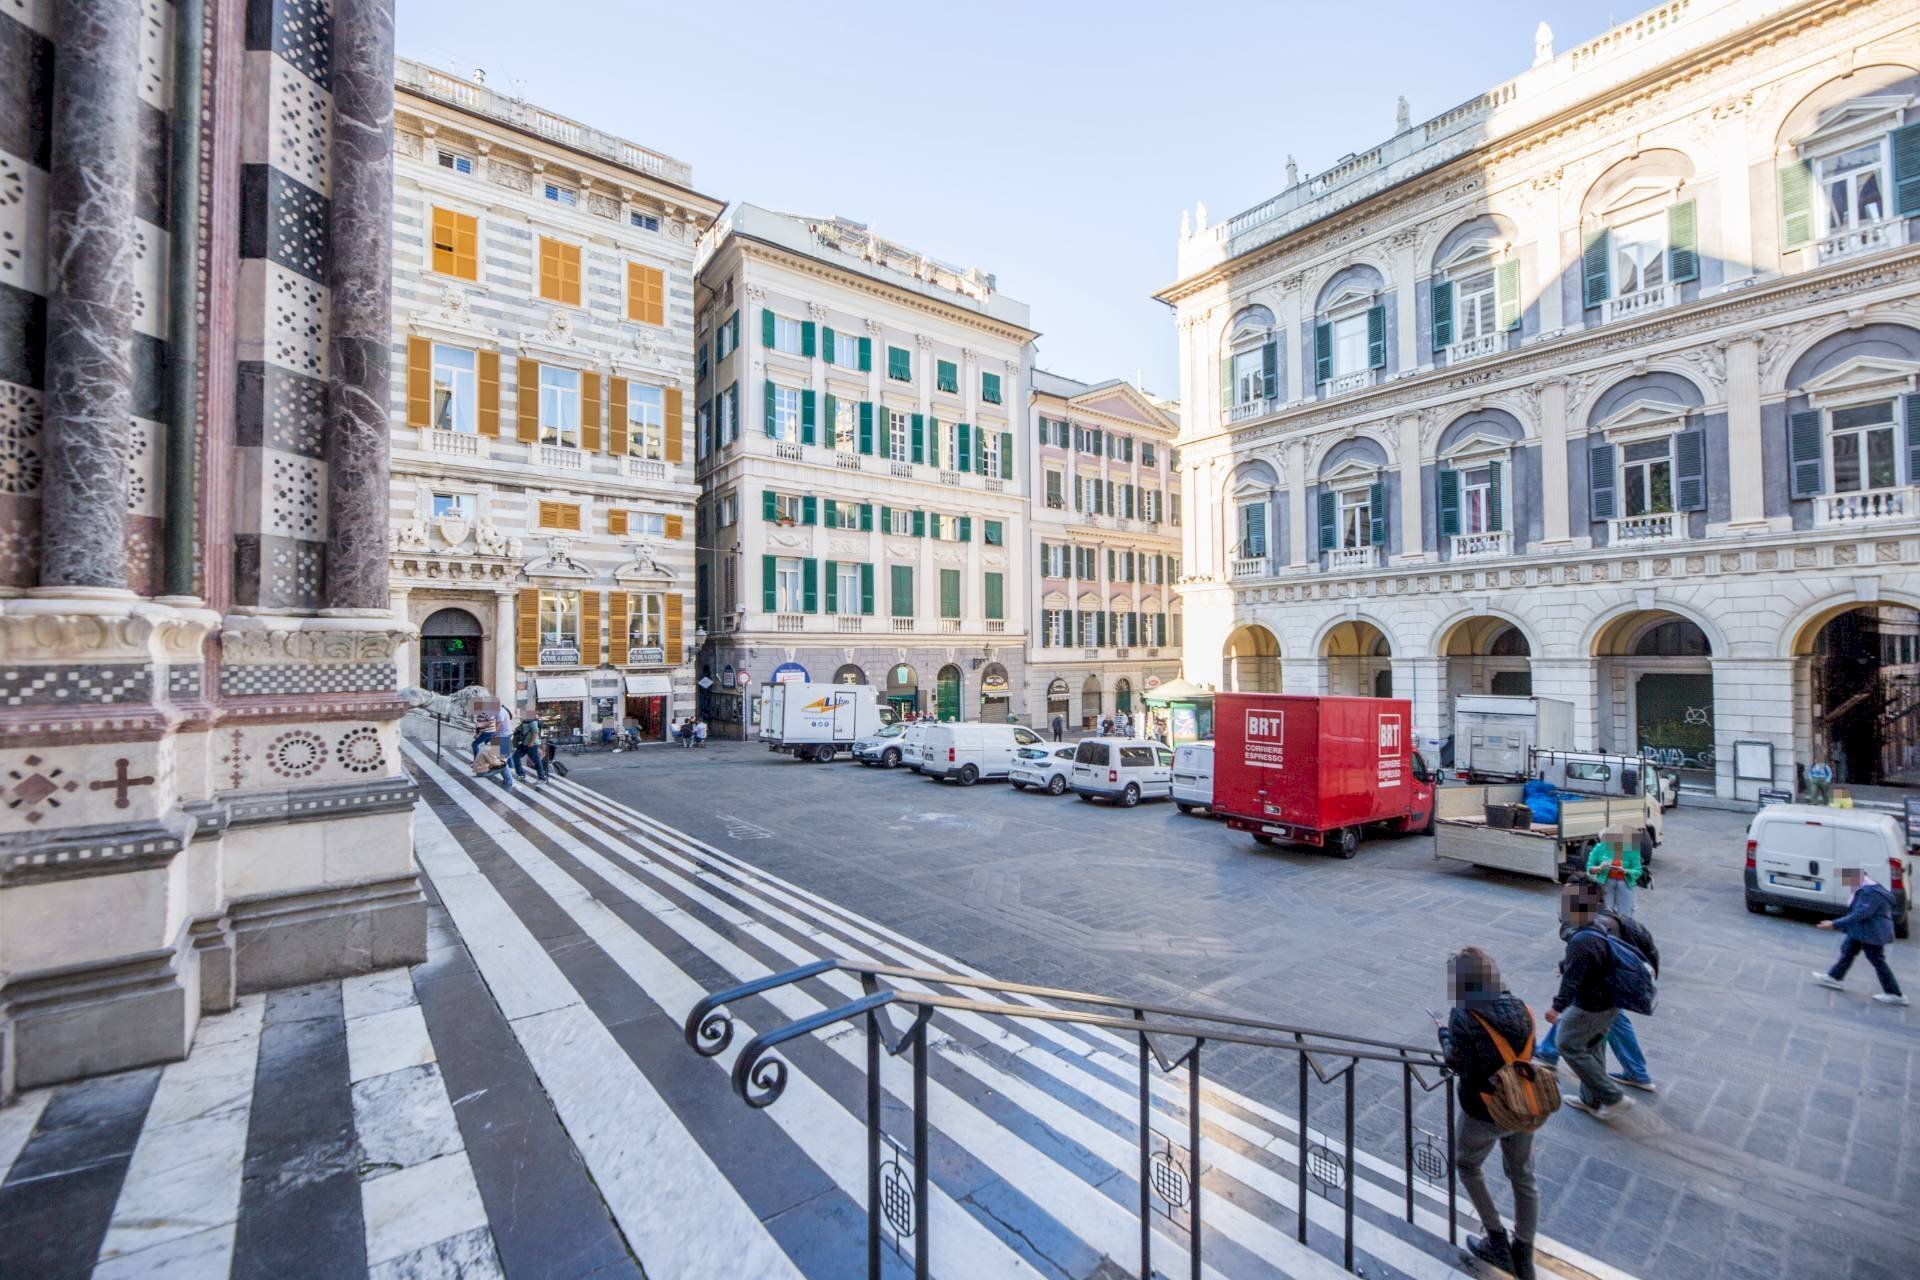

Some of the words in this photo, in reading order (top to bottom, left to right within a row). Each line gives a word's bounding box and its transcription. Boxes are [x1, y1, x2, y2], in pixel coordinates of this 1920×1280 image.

[1249, 716, 1280, 737] BRT
[1380, 724, 1399, 747] BRT
[1245, 744, 1283, 755] CORRIERE
[1245, 751, 1283, 762] ESPRESSO
